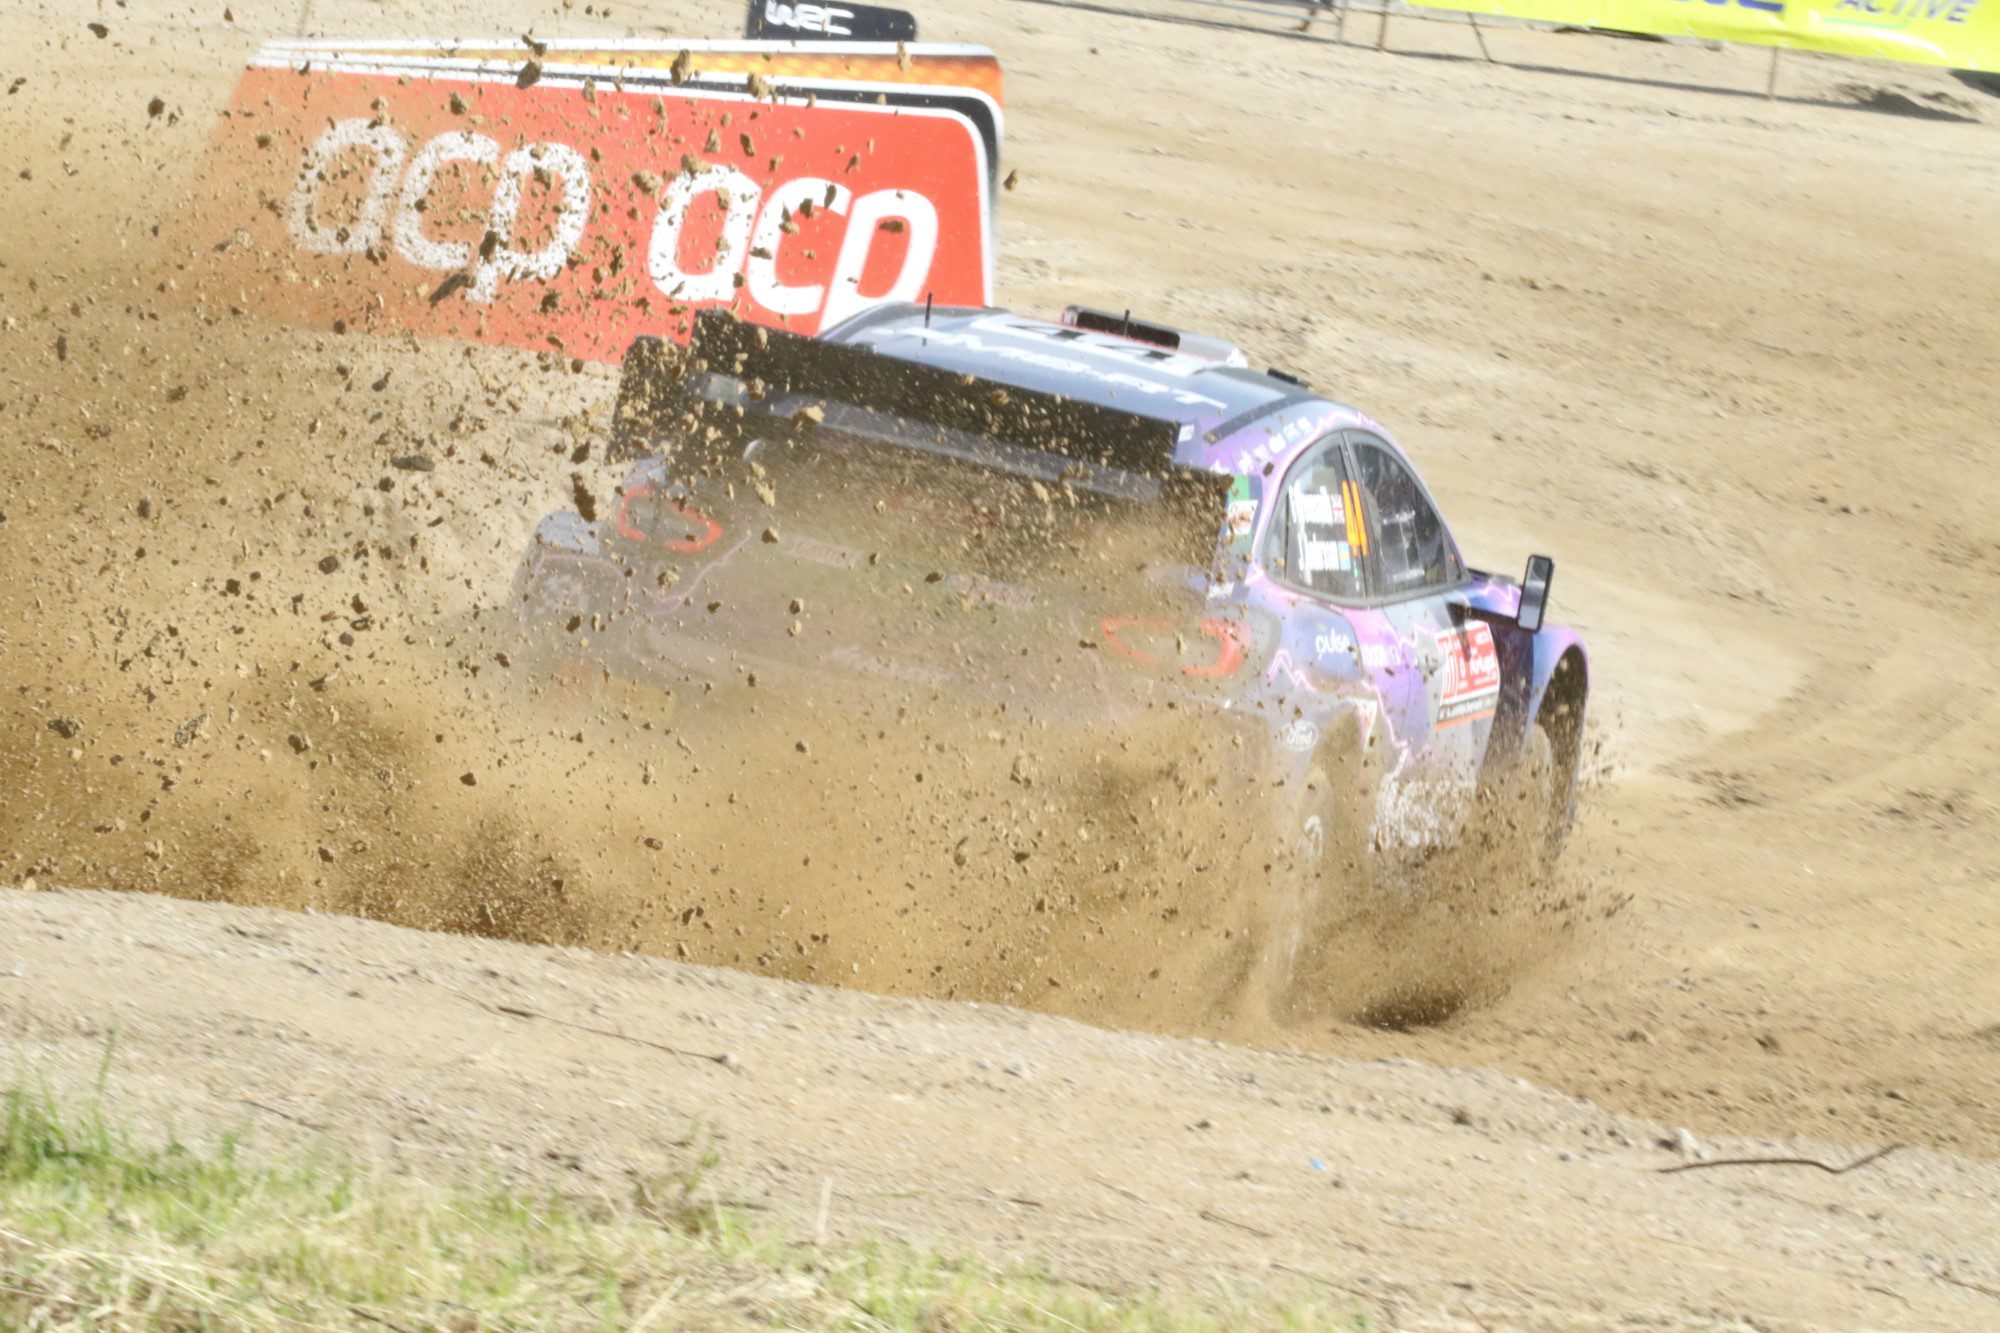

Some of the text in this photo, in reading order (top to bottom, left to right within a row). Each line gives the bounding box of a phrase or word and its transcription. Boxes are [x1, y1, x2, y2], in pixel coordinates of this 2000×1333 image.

[764, 0, 854, 35] WRC
[286, 117, 940, 334] acp acp
[1315, 626, 1351, 661] pulse
